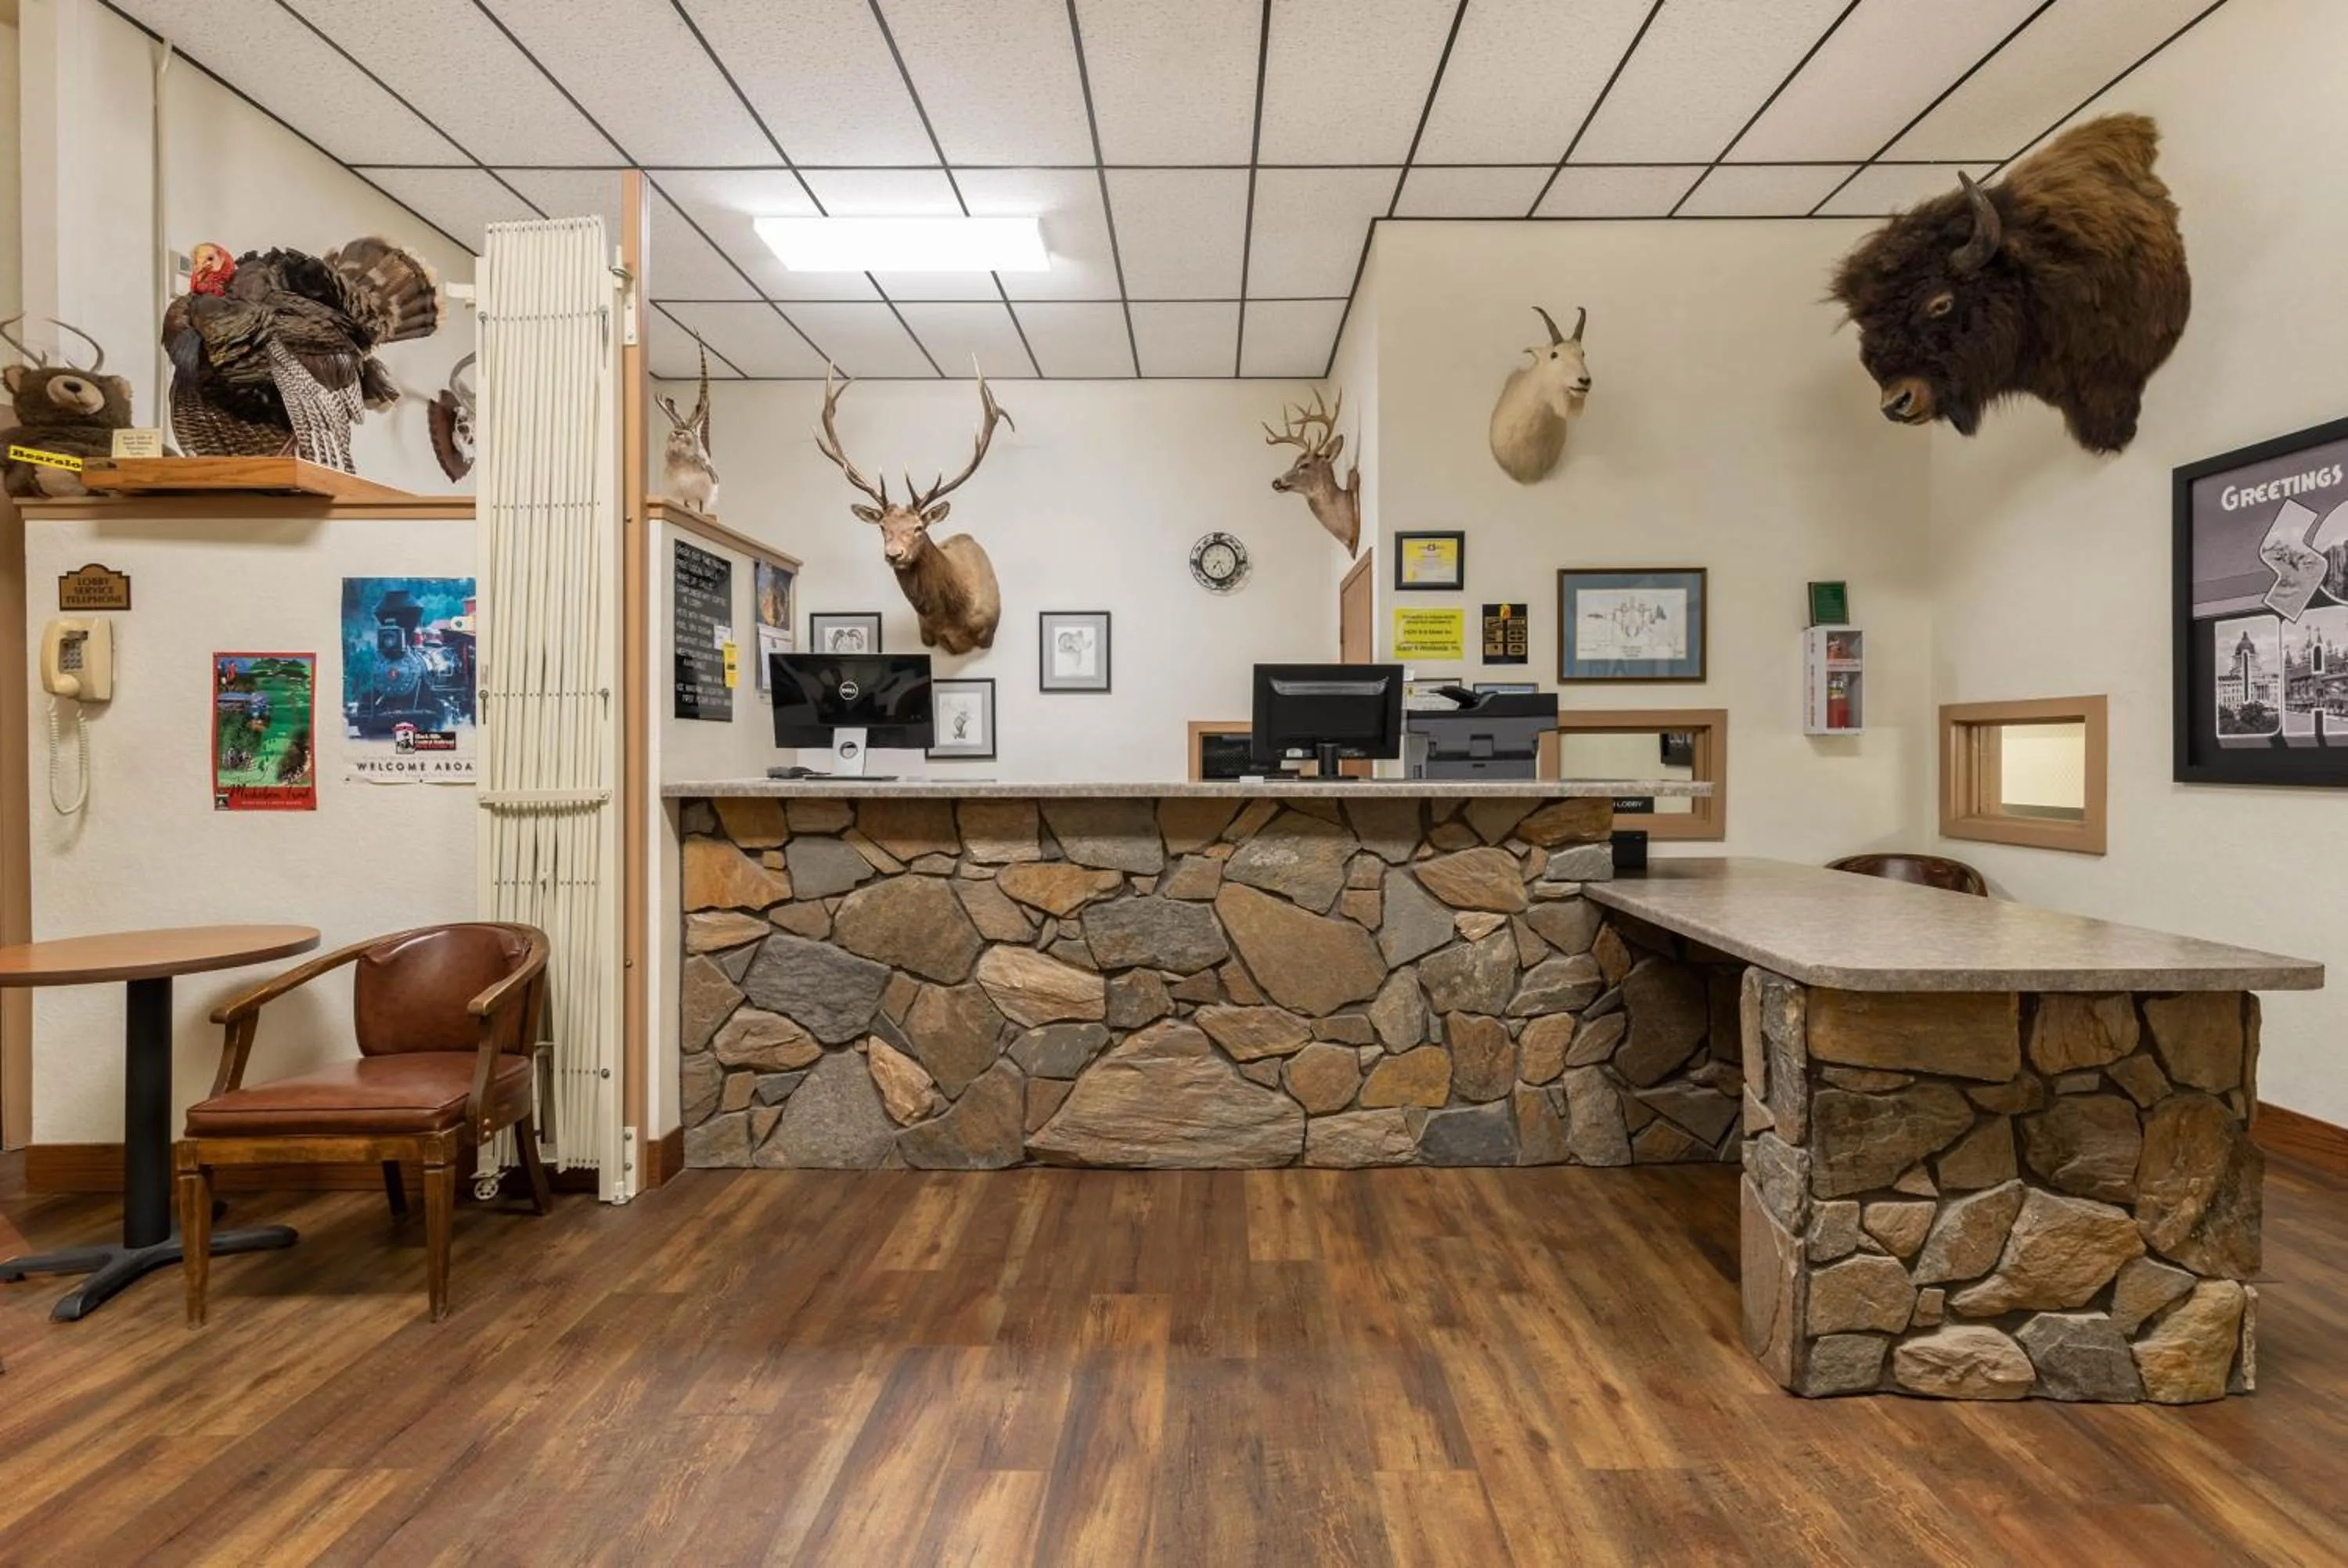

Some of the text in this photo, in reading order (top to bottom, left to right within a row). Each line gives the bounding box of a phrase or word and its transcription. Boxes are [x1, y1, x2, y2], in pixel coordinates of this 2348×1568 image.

[2220, 463, 2343, 511] GREETINGS
[77, 577, 109, 586] LOBBY
[357, 761, 426, 771] WELCOME
